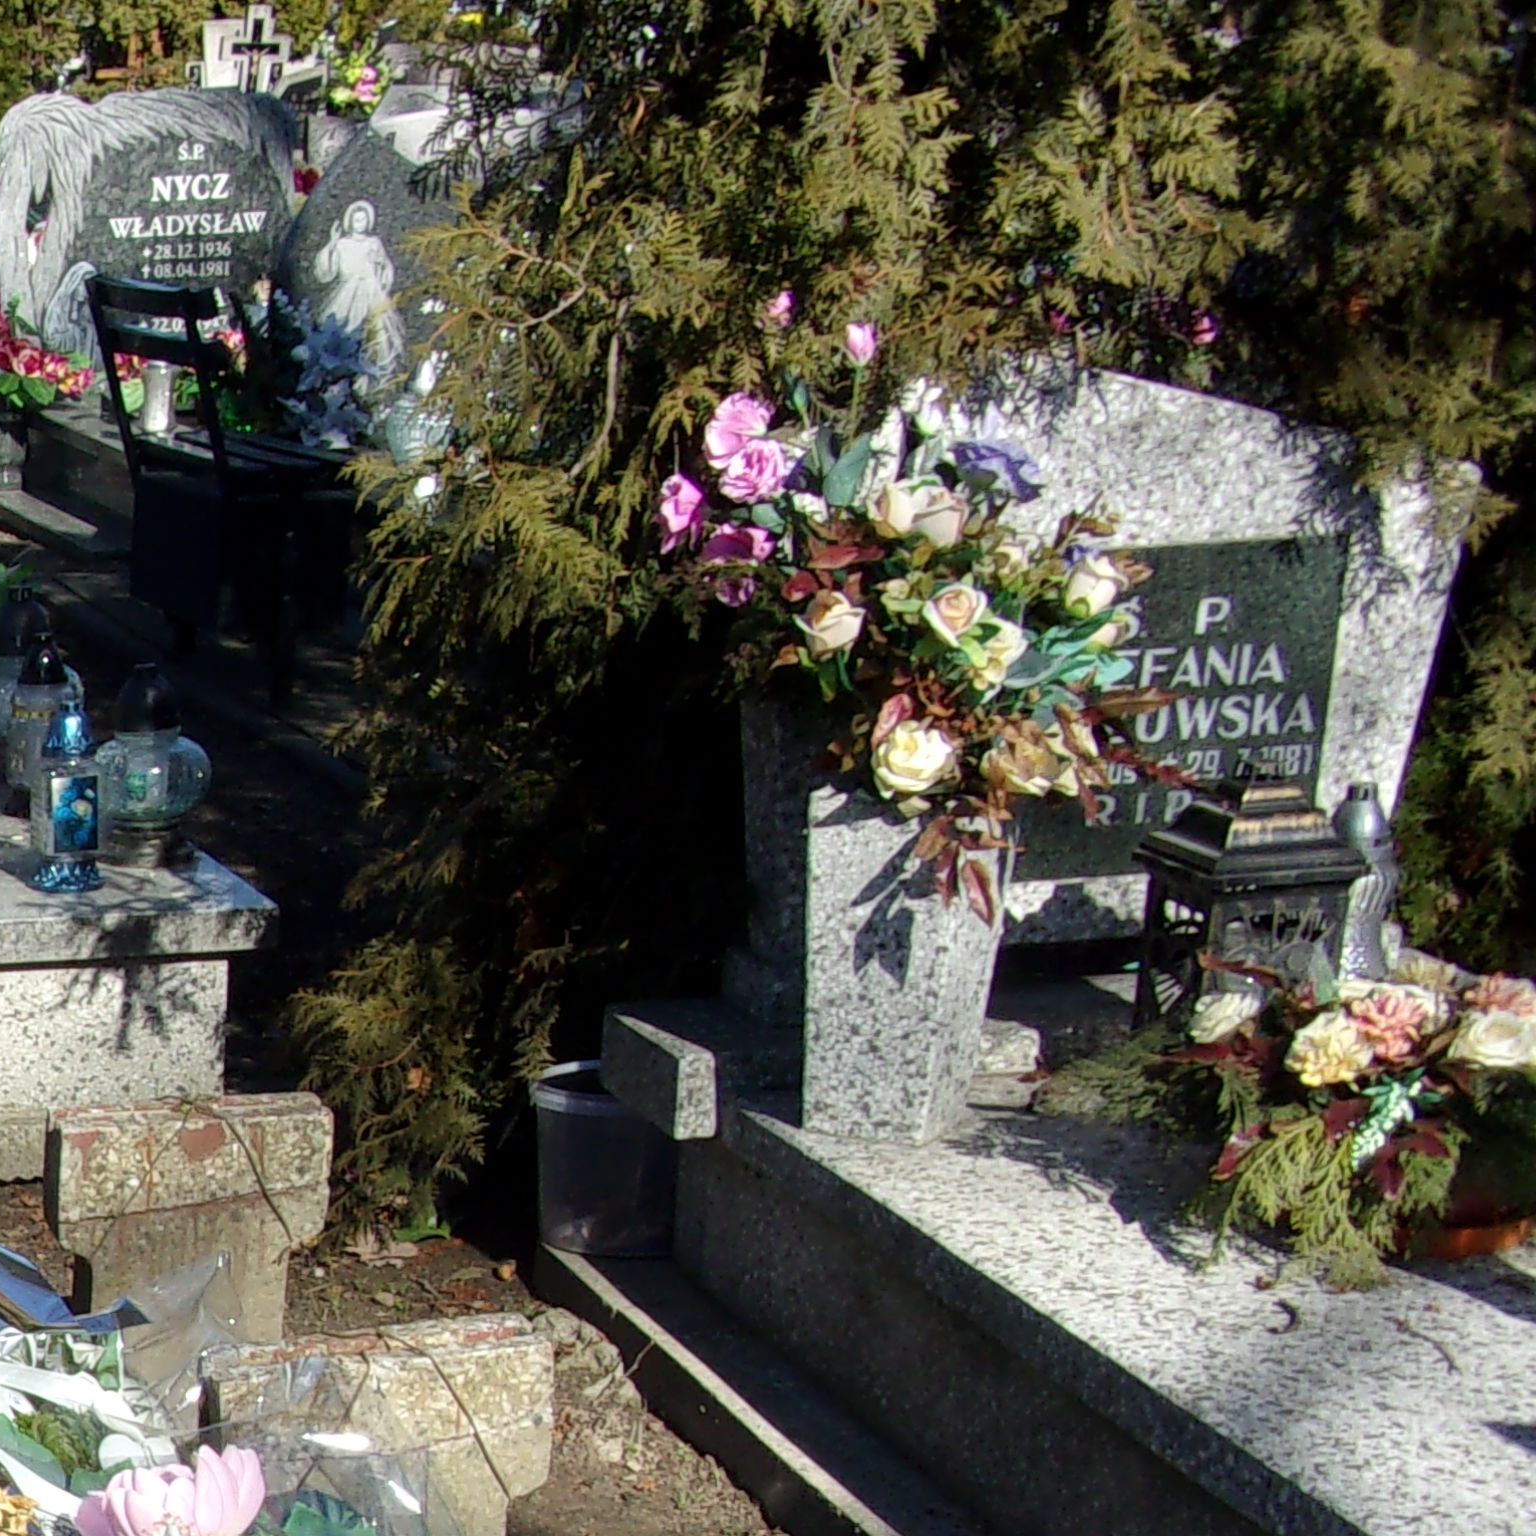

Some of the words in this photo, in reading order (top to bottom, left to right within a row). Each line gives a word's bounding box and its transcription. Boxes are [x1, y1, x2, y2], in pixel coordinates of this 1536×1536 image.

[150, 172, 231, 203] NYCZ
[108, 210, 268, 240] WŁADYSŁAW
[153, 240, 233, 261] 28.12.1936
[153, 260, 231, 280] 08.04.1981
